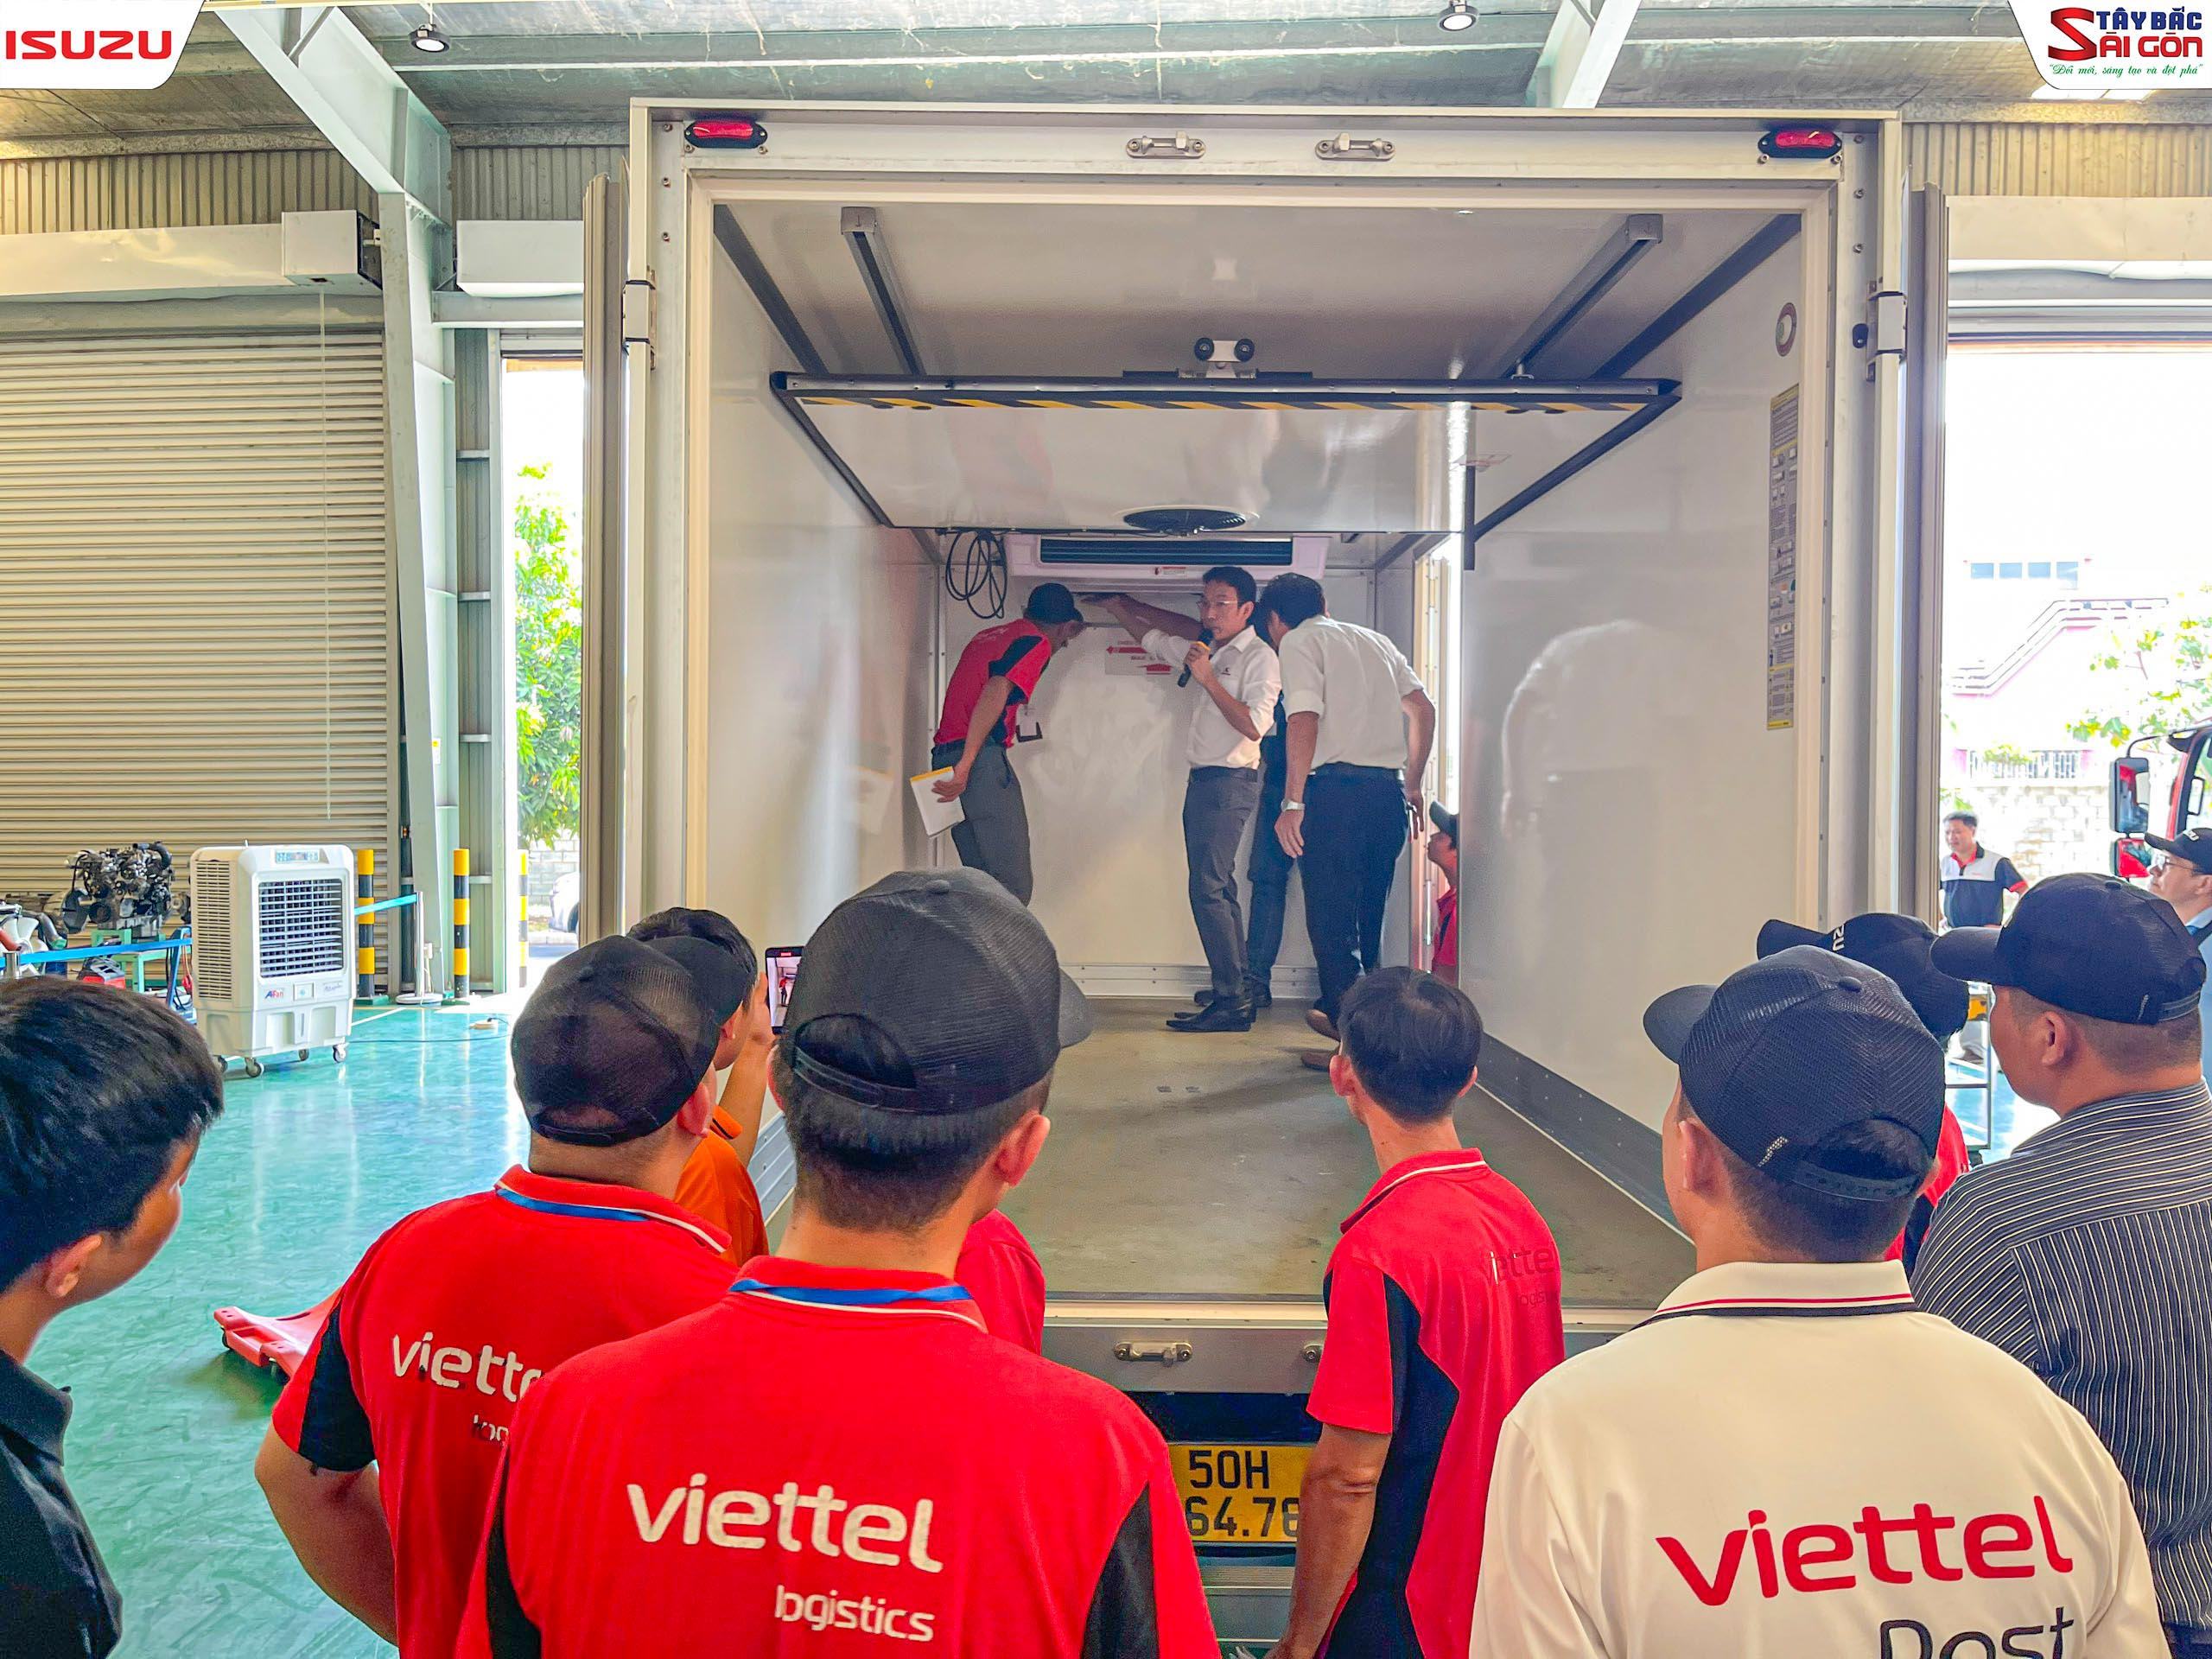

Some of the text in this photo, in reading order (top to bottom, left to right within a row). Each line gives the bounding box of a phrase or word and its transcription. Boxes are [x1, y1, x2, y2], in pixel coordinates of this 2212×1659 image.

[1189, 1450, 1270, 1490] 50H
[626, 1472, 944, 1573] viettel
[1655, 1495, 2074, 1606] viettel
